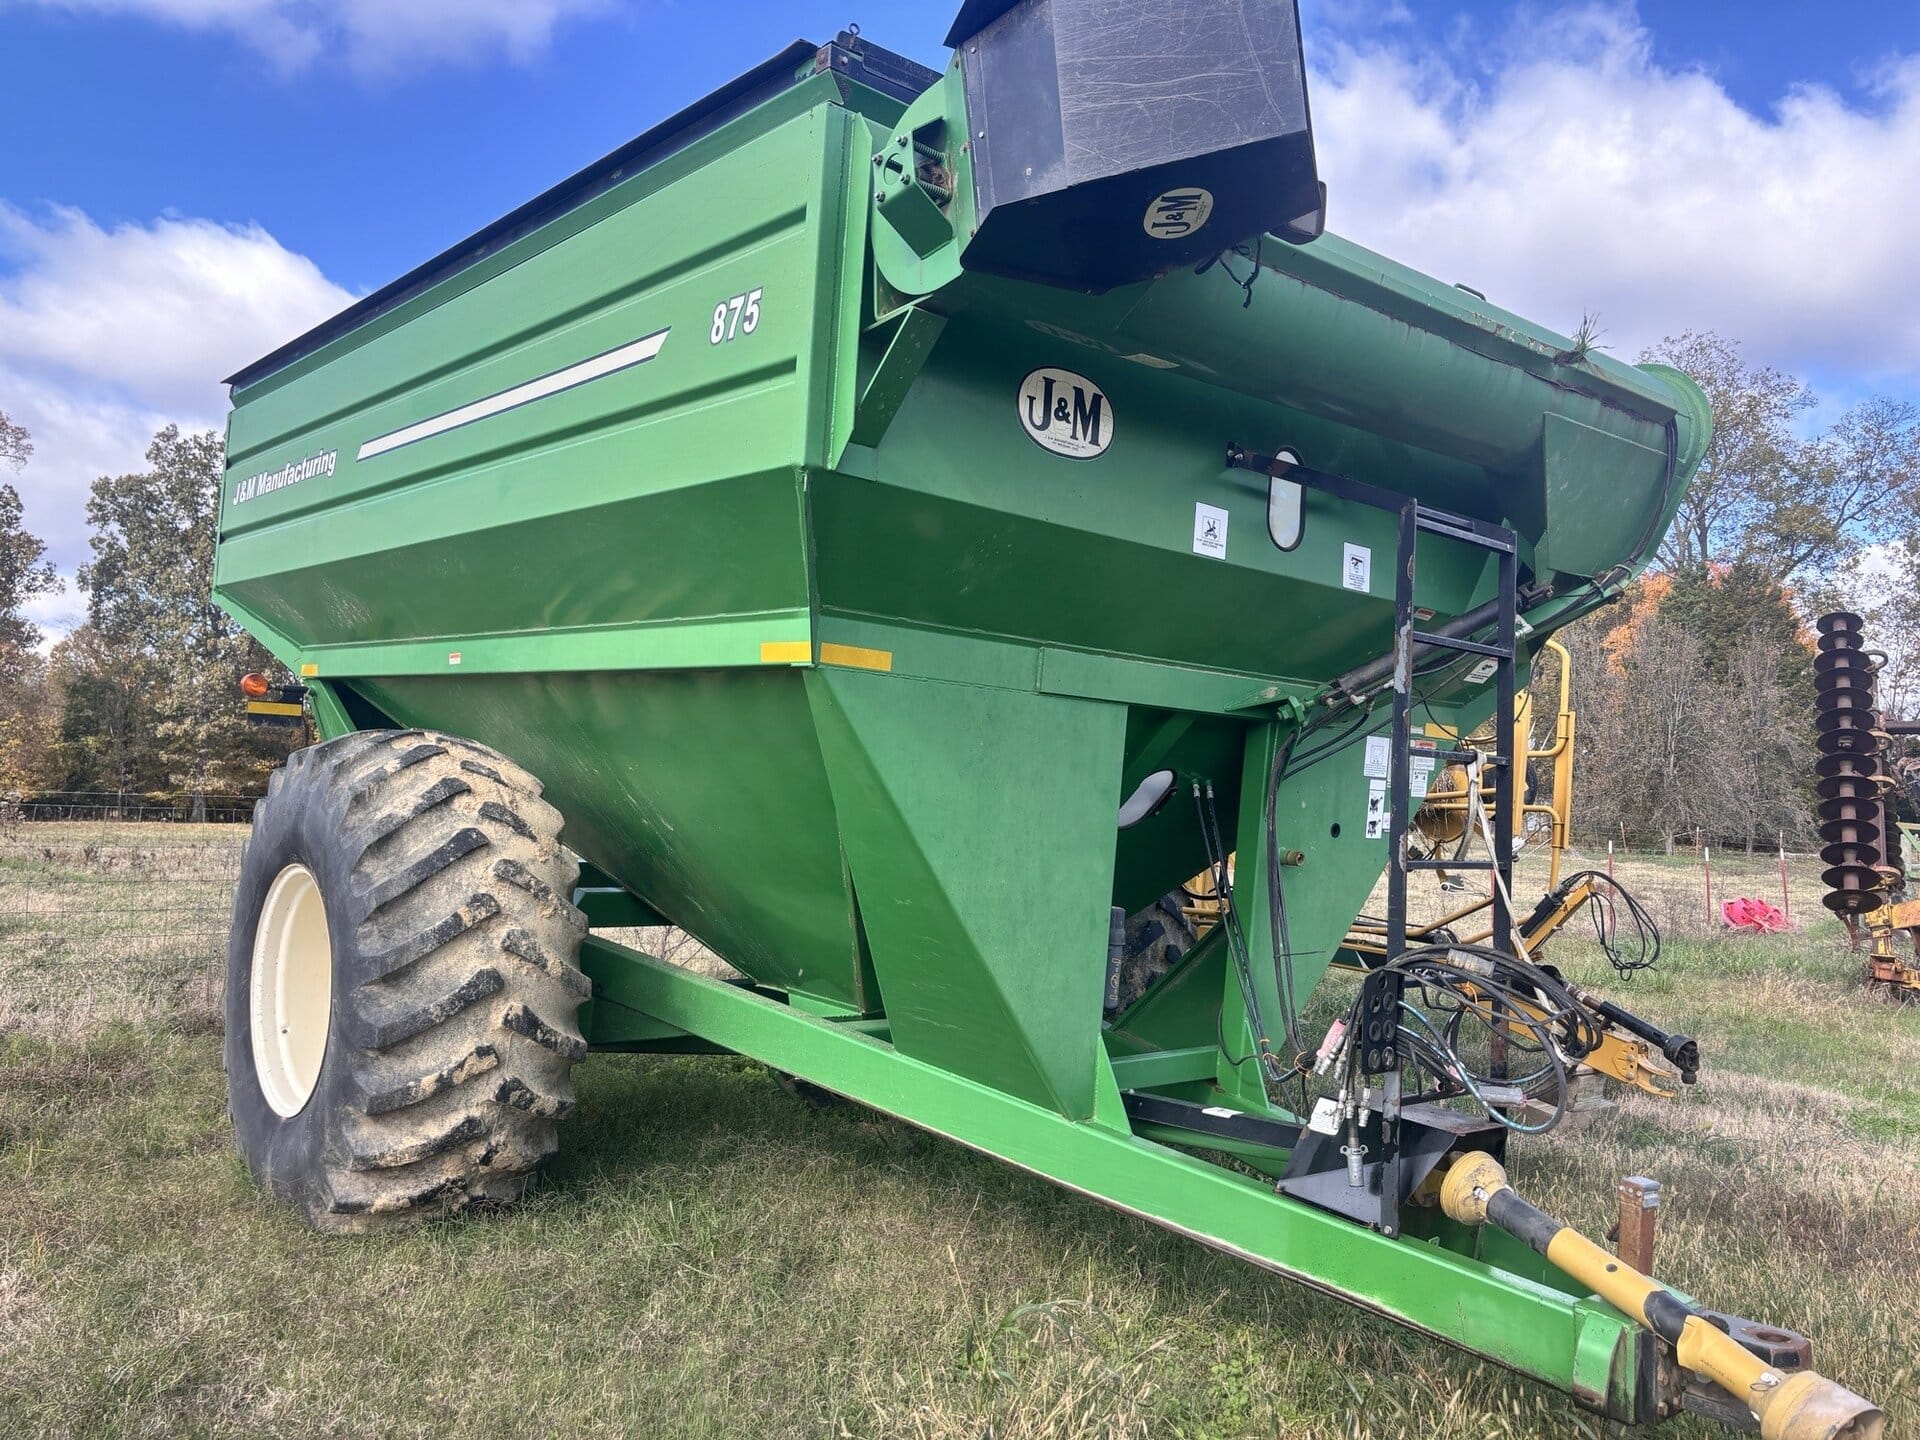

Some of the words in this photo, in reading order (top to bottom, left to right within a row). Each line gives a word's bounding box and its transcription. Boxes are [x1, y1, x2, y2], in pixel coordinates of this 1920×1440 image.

[1151, 192, 1204, 236] J&M
[710, 286, 763, 345] 875
[1027, 376, 1104, 447] J&M
[233, 475, 257, 506] J&M
[256, 448, 338, 497] Manufacturing
